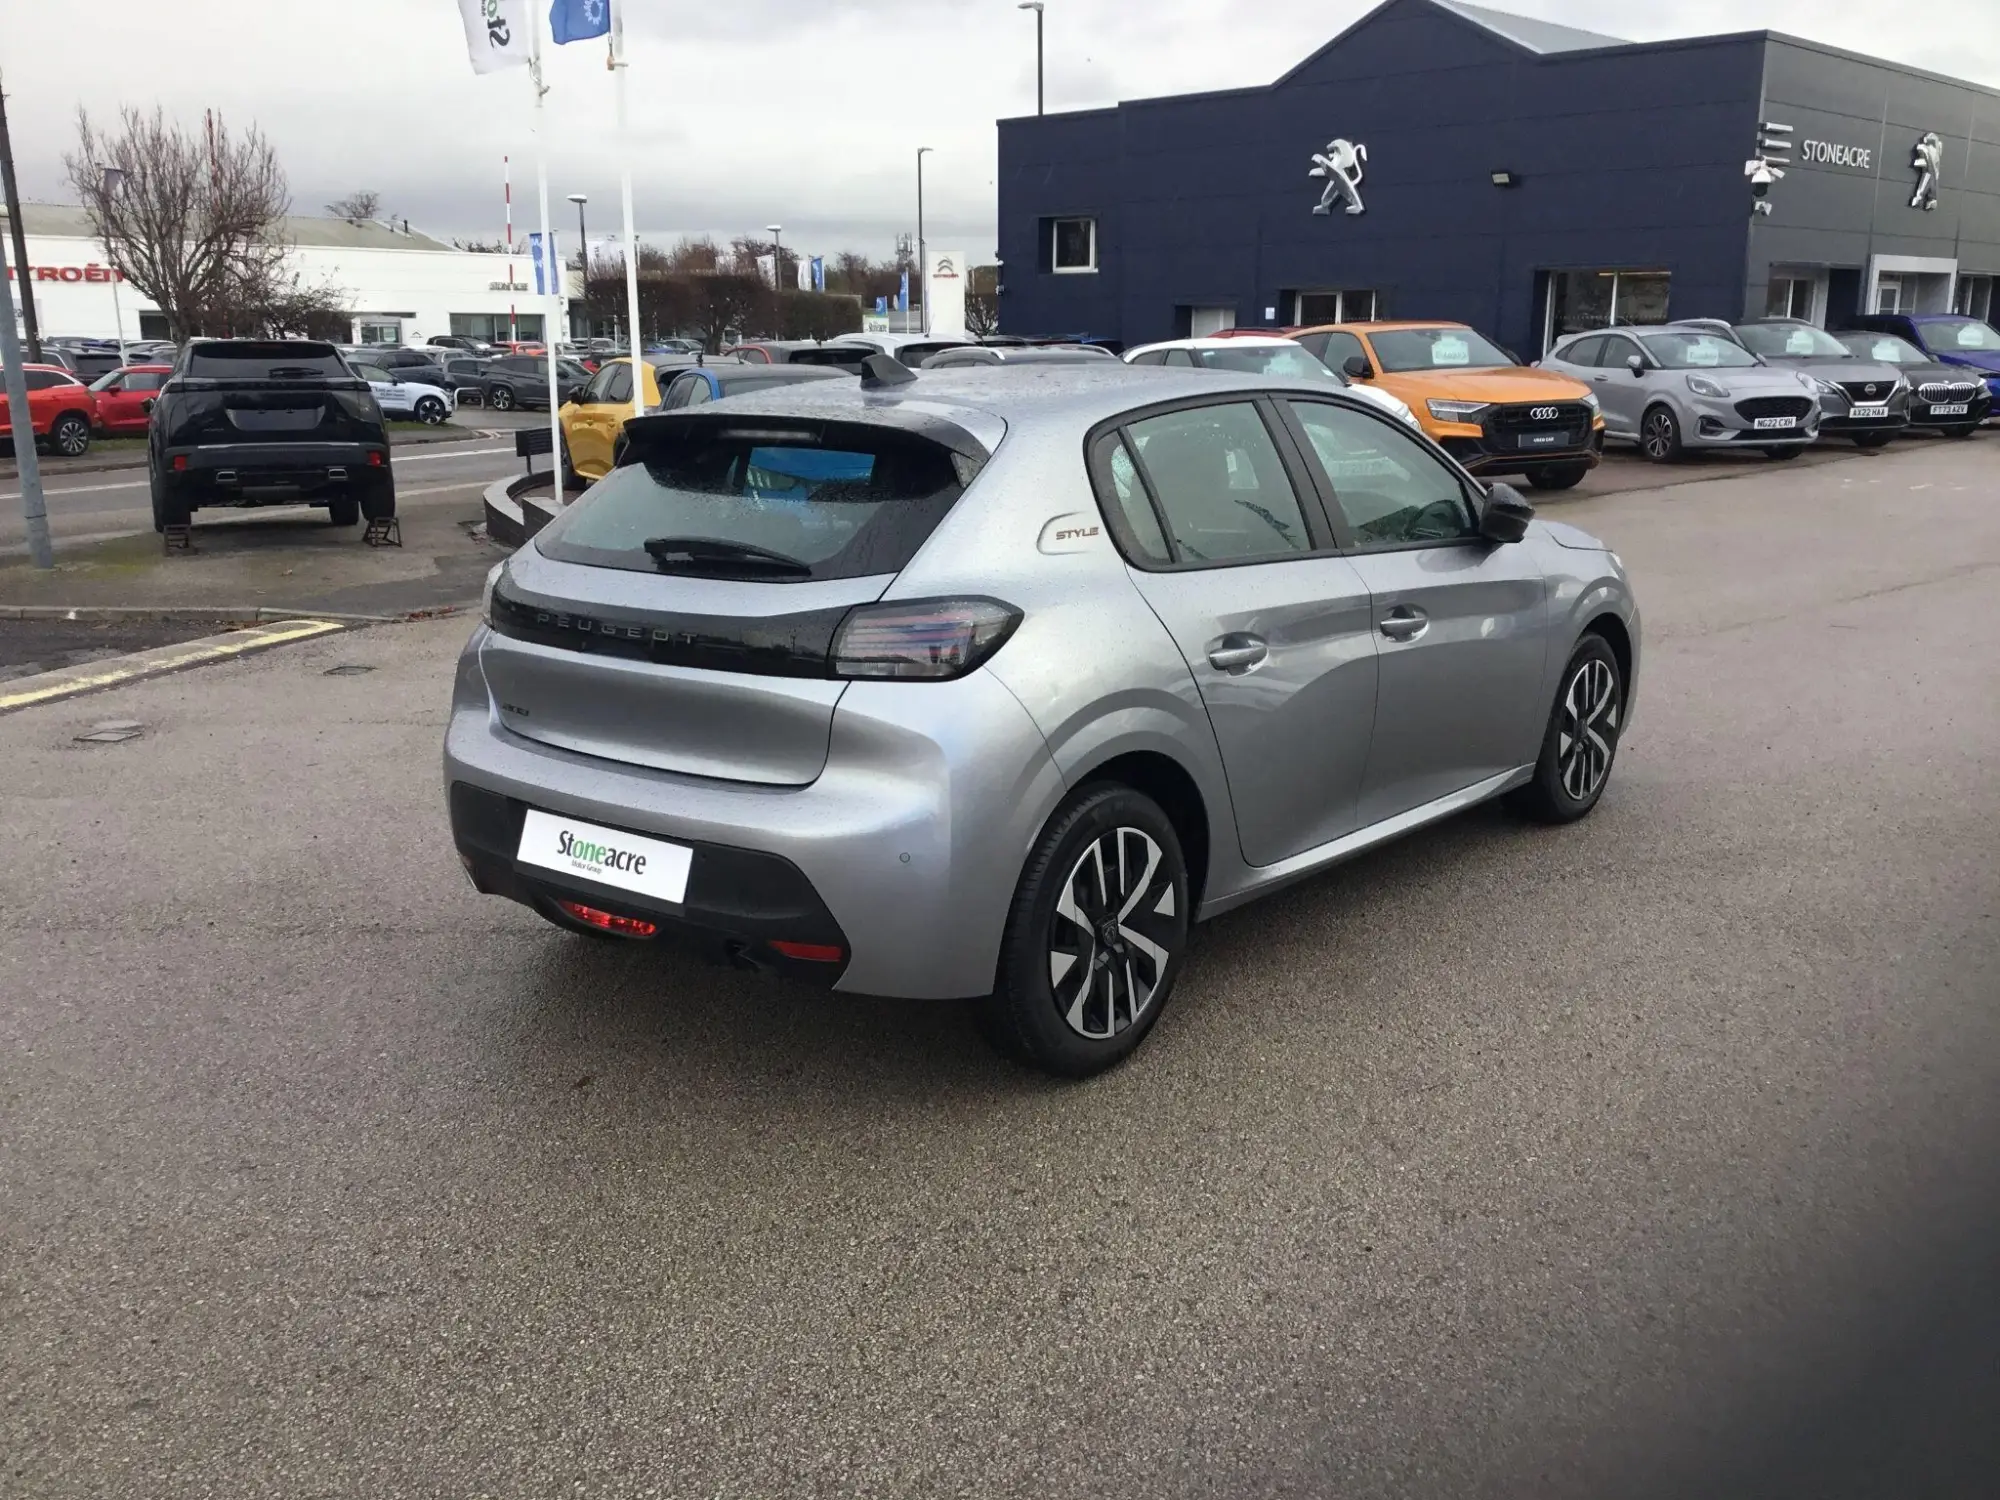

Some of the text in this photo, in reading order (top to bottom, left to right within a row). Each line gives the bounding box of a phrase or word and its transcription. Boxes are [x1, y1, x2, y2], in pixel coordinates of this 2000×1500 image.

[1802, 139, 1871, 169] STONEACRE
[1757, 417, 1793, 428] NG22 CXH
[1056, 527, 1099, 540] STYLE
[537, 613, 698, 644] PEUGEOT
[557, 830, 647, 875] Stoneacre
